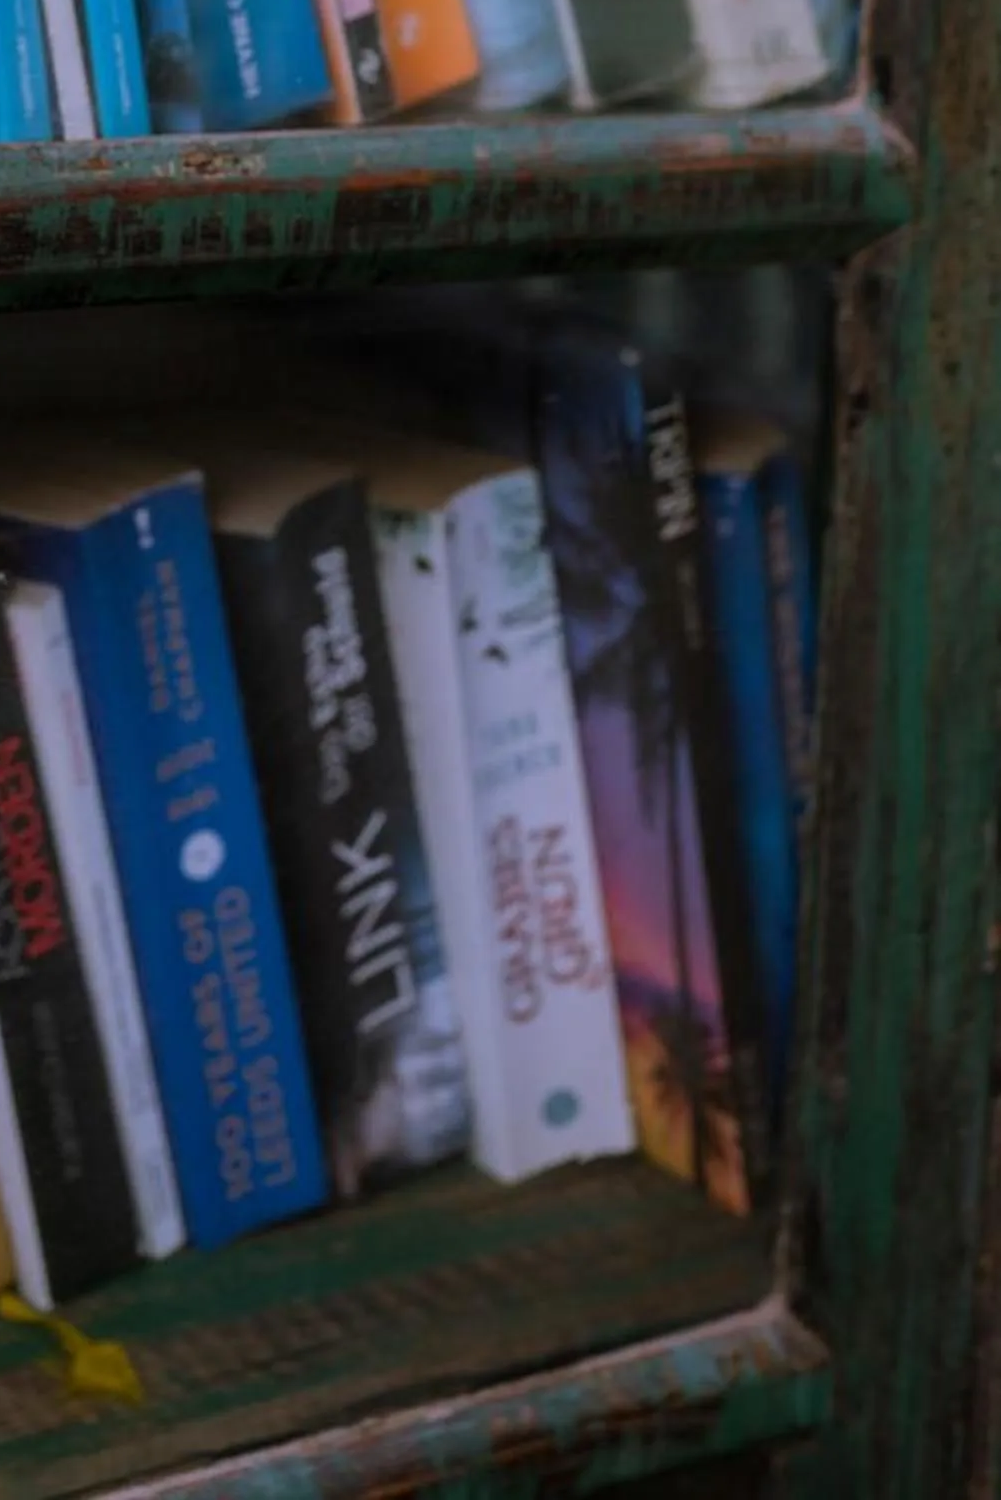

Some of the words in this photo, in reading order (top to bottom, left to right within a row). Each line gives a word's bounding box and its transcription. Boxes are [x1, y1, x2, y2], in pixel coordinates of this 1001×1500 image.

[214, 886, 273, 1049] UNITED
[331, 810, 416, 1034] LINK
[216, 1113, 255, 1202] 100
[242, 1055, 297, 1188] LEEDS
